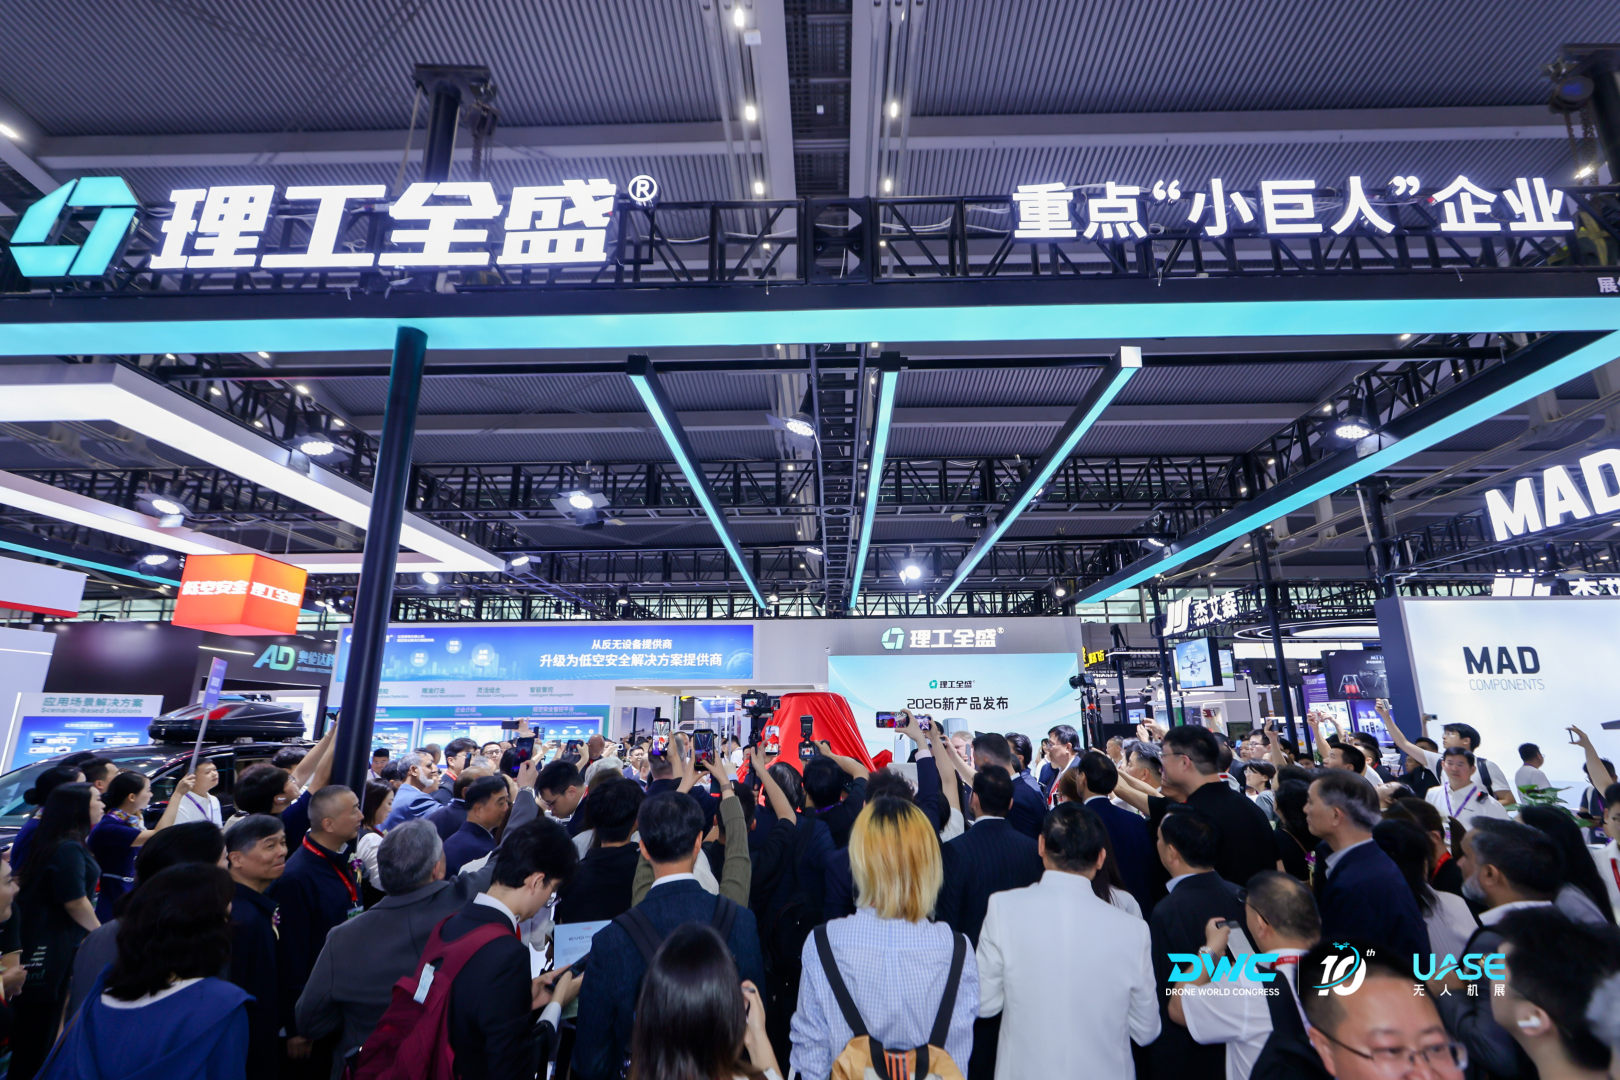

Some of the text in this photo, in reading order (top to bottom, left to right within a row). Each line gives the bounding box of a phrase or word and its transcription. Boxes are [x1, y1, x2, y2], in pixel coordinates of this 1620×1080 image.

[1597, 277, 1620, 293] 展
[1485, 448, 1620, 541] MAD
[592, 639, 672, 650] 从反无设备提供商
[539, 653, 723, 667] 升级为低空安全解决方案提供商
[1463, 646, 1541, 675] MAD
[1469, 678, 1545, 691] COMPONENTS
[907, 697, 1009, 711] 2026新产品发布
